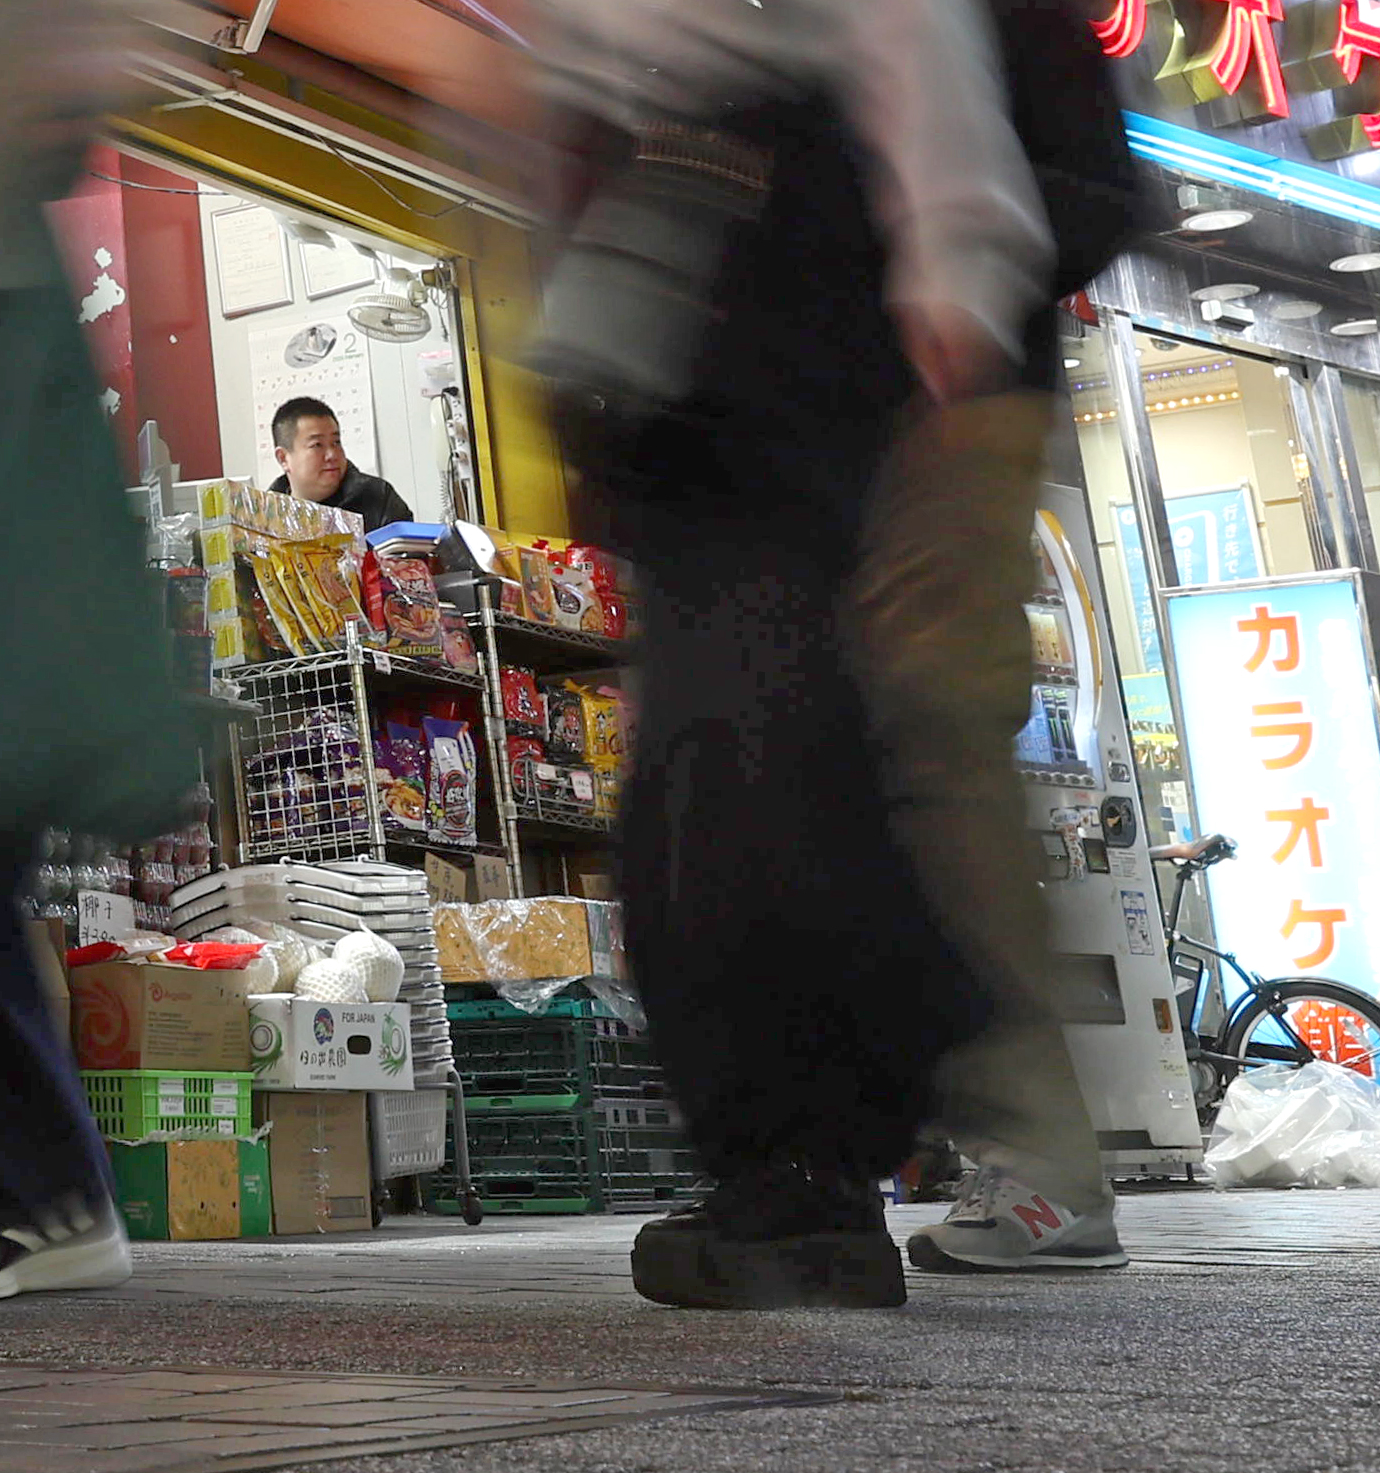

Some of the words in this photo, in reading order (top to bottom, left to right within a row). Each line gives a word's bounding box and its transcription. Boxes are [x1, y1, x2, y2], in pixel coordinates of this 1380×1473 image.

[343, 331, 358, 355] 2
[341, 1011, 356, 1024] FOR
[357, 1013, 377, 1025] JAPAN
[1011, 1193, 1063, 1240] N
